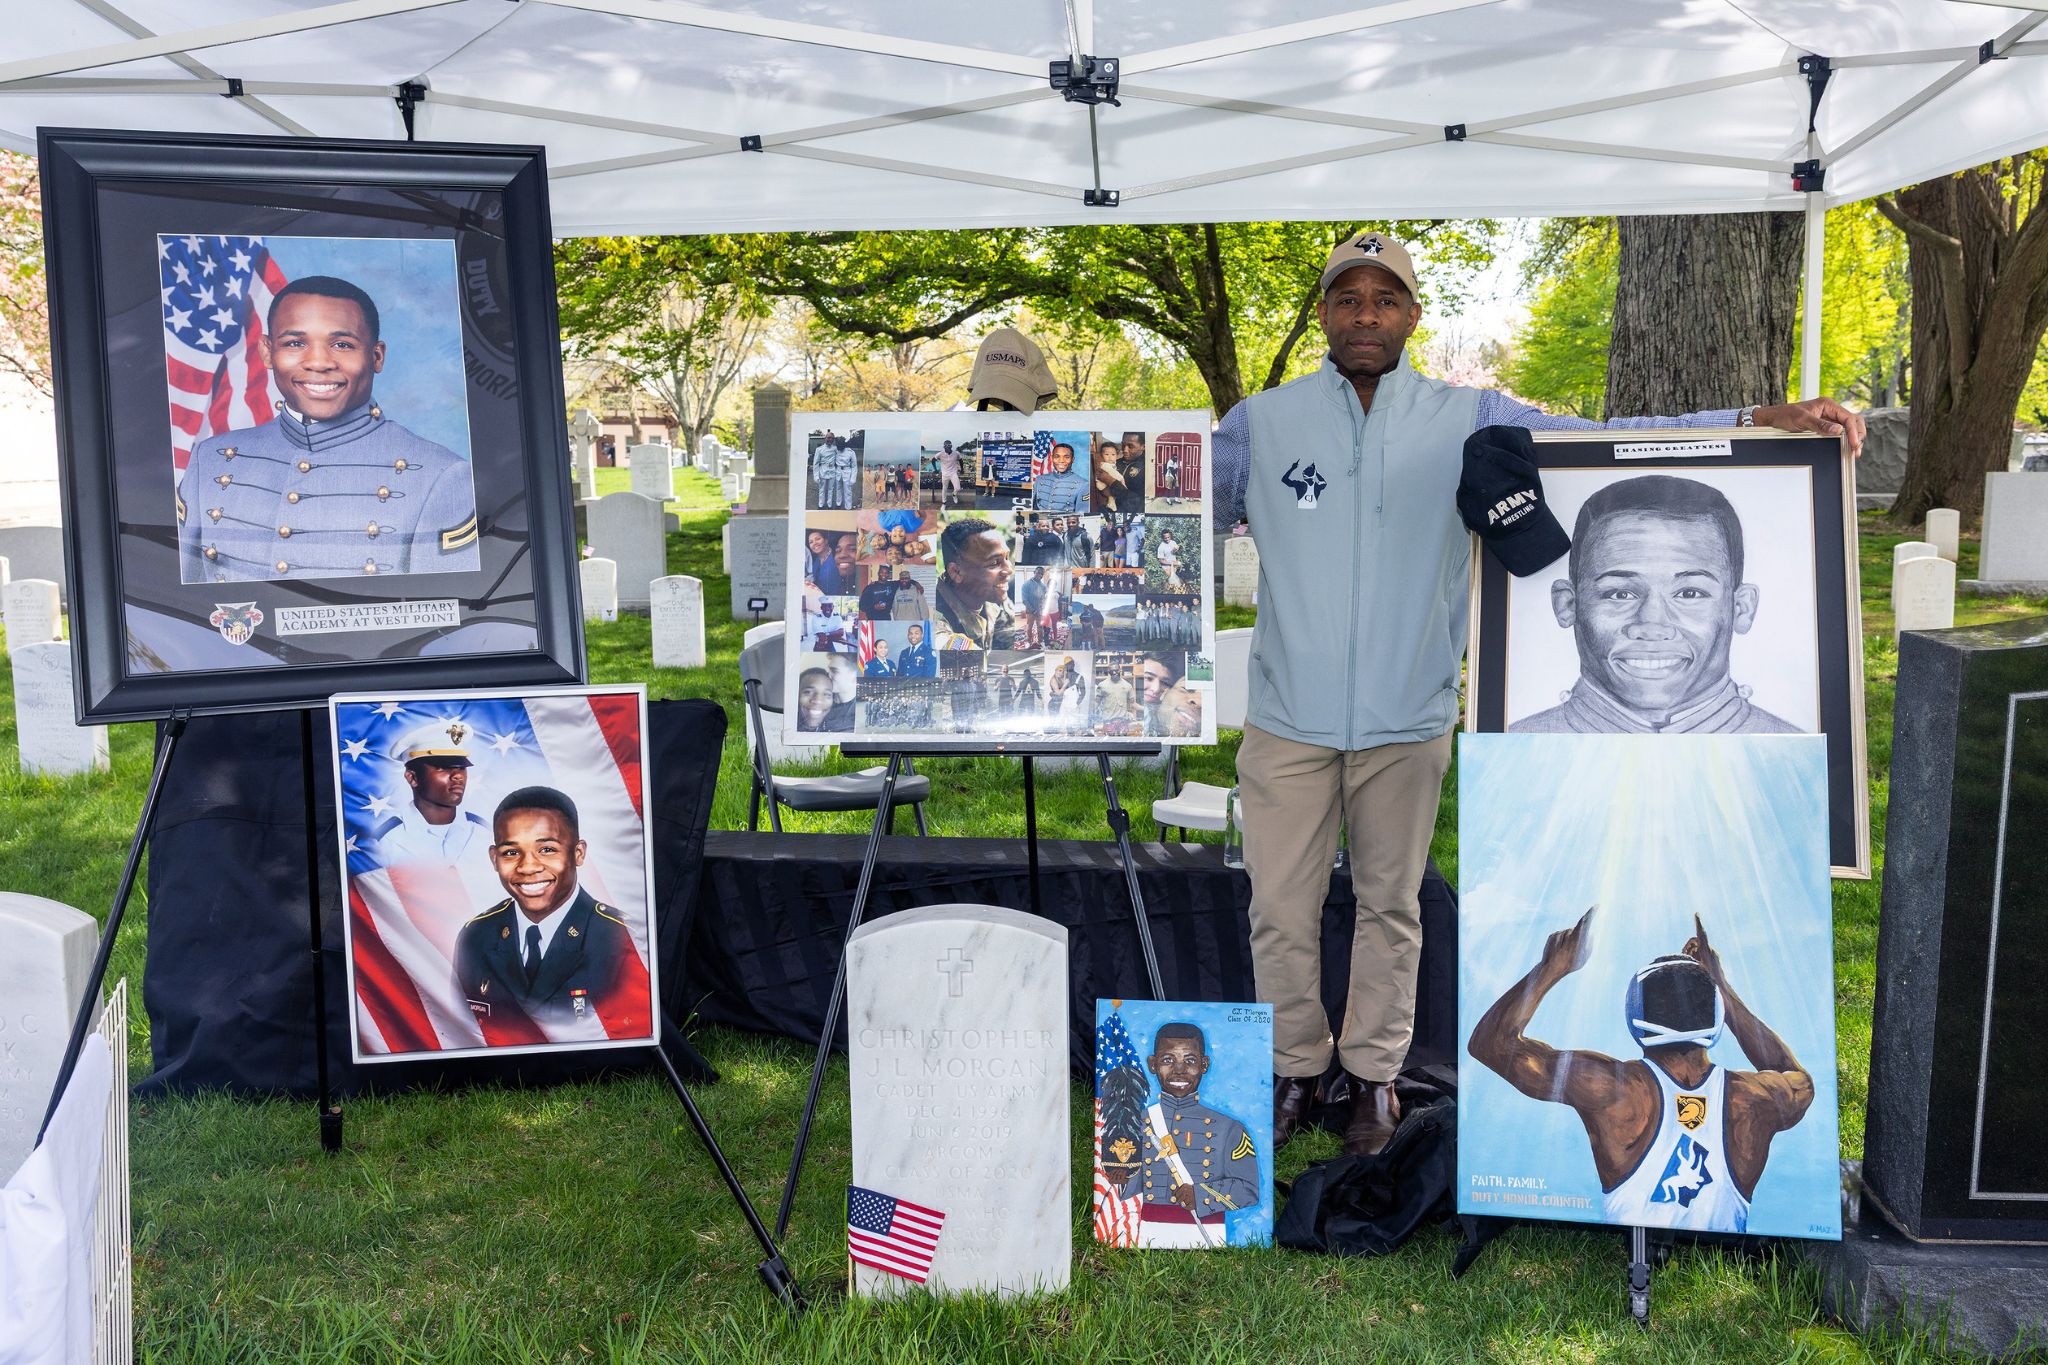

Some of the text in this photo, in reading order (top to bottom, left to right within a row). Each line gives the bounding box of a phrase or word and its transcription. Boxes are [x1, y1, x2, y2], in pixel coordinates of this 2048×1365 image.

[466, 258, 502, 317] DUTY
[986, 353, 1026, 367] USMAPS
[1304, 494, 1313, 503] CJ
[1487, 489, 1538, 526] ARMY
[1501, 503, 1535, 527] WRESTLING
[281, 602, 455, 621] UNITED STATES MILITARY
[282, 612, 455, 631] ACADEMY AT WEST POINT
[1254, 1016, 1271, 1024] 2020
[858, 1028, 1055, 1049] CHRISTOPHER
[865, 1056, 1049, 1078] J L MORGAN
[876, 1083, 1040, 1098] CADET US ARMY
[907, 1105, 1010, 1119] DEC 4 1996
[910, 1125, 1012, 1139] JUN 6 2019
[924, 1145, 994, 1160] ARCOM
[885, 1165, 1033, 1180] CLASS OF 2020
[1471, 1174, 1548, 1190] FAITH. FAMILY.
[935, 1185, 984, 1200] USMA
